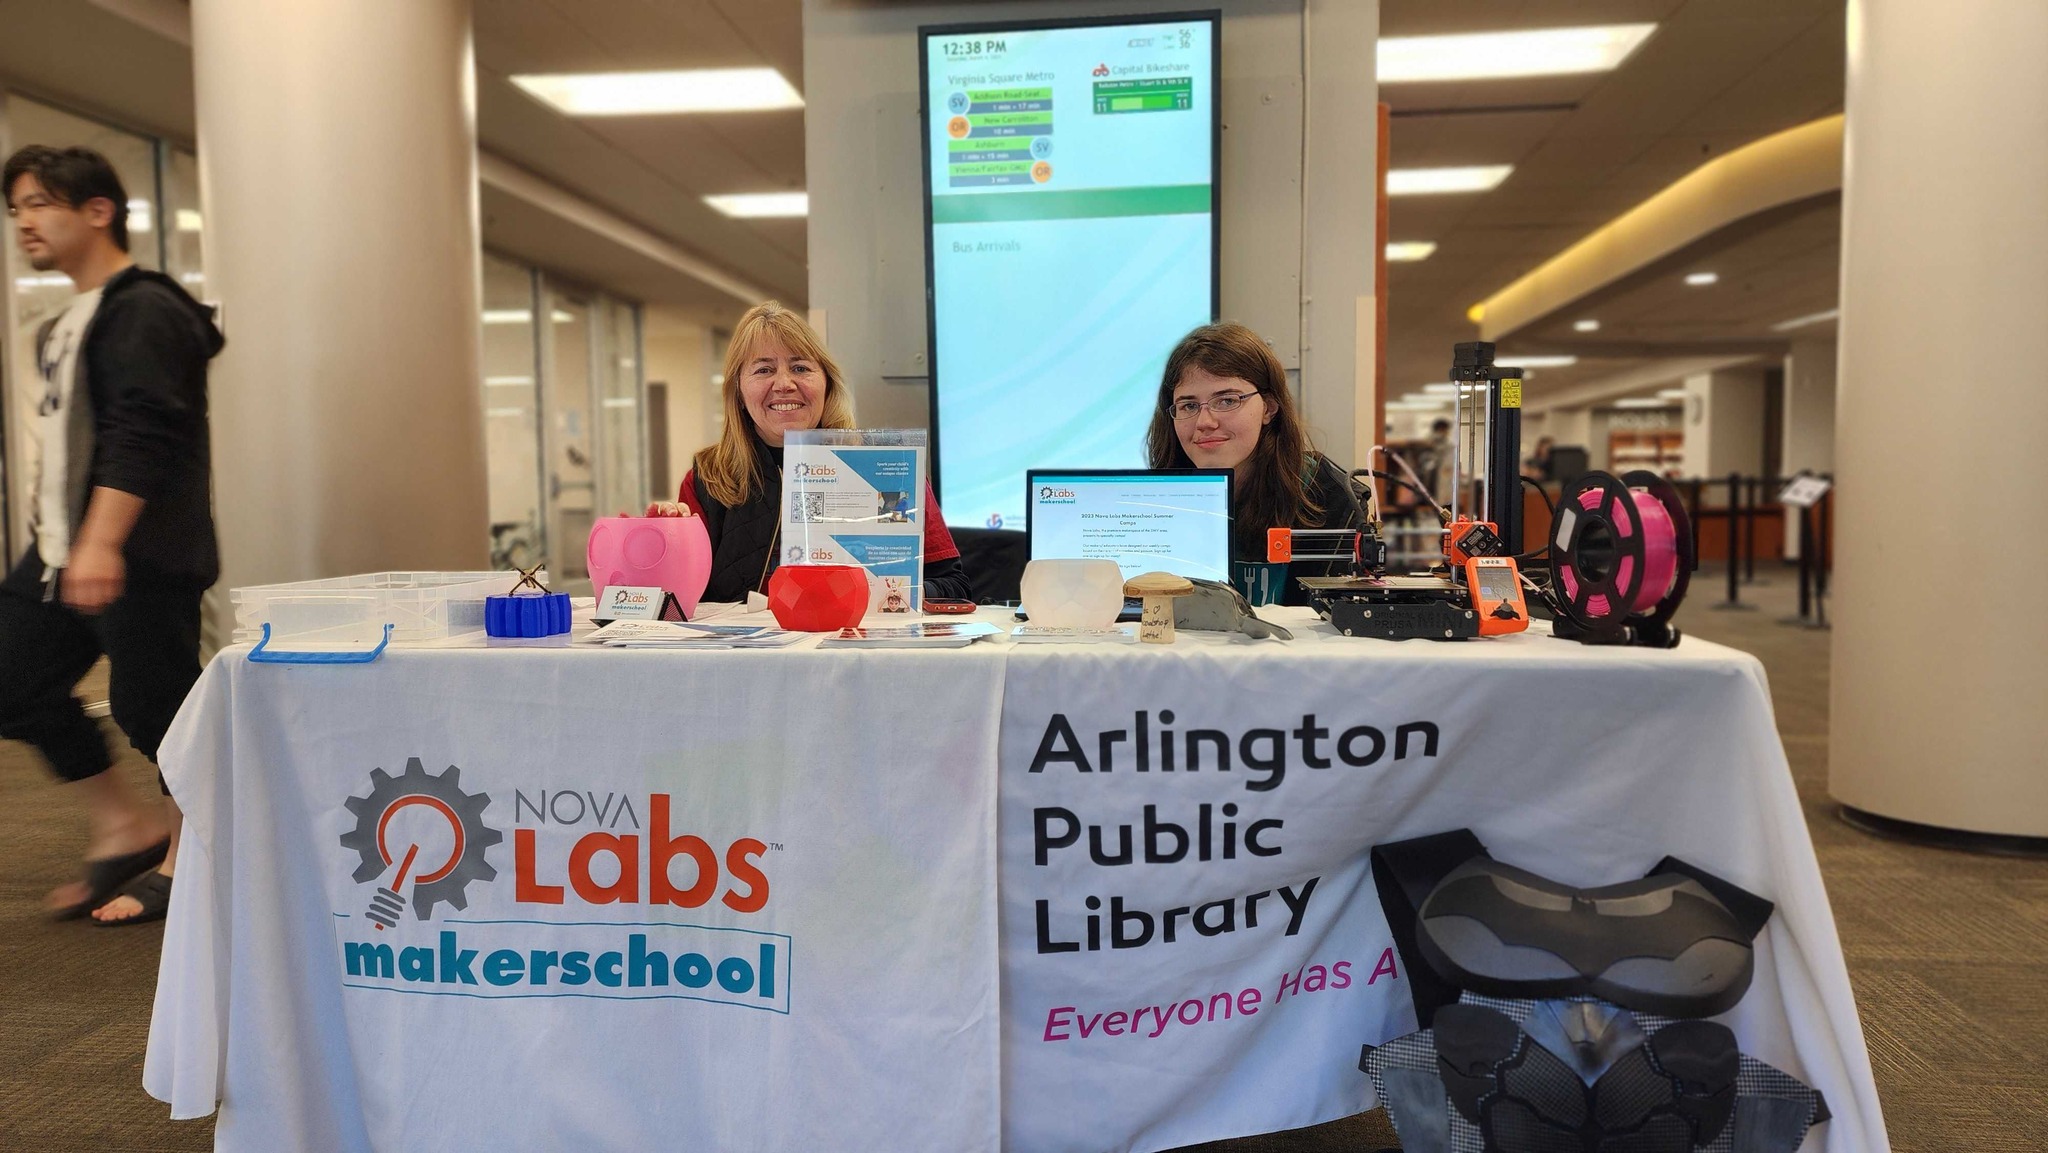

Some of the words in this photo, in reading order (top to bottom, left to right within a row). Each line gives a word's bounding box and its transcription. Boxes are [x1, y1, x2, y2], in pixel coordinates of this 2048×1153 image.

[942, 42, 982, 55] 12:38
[986, 40, 1007, 53] PM
[1112, 64, 1144, 76] Capital
[1146, 63, 1190, 72] Bikeshare
[948, 74, 986, 87] Virginia
[988, 73, 1023, 85] Square
[1024, 71, 1055, 82] Metro
[952, 98, 964, 108] SV
[1097, 104, 1107, 112] 11
[1178, 98, 1188, 108] 11
[951, 122, 966, 132] OR
[1036, 142, 1049, 153] SV
[1036, 167, 1051, 176] OR
[952, 242, 972, 252] Bus
[976, 240, 1021, 252] Arrivals
[810, 464, 836, 476] Labs
[1054, 488, 1075, 498] Labs
[628, 592, 648, 603] Labs
[1374, 620, 1413, 629] PRUSA
[1028, 708, 1440, 792] Arlington
[515, 788, 640, 829] NOVA
[1033, 802, 1284, 866] Public
[515, 794, 770, 913] Labs
[1035, 876, 1321, 954] Library
[344, 930, 775, 999] makerschool
[1042, 987, 1262, 1042] Everyone
[1275, 960, 1352, 1004] Has
[1367, 946, 1399, 986] A
